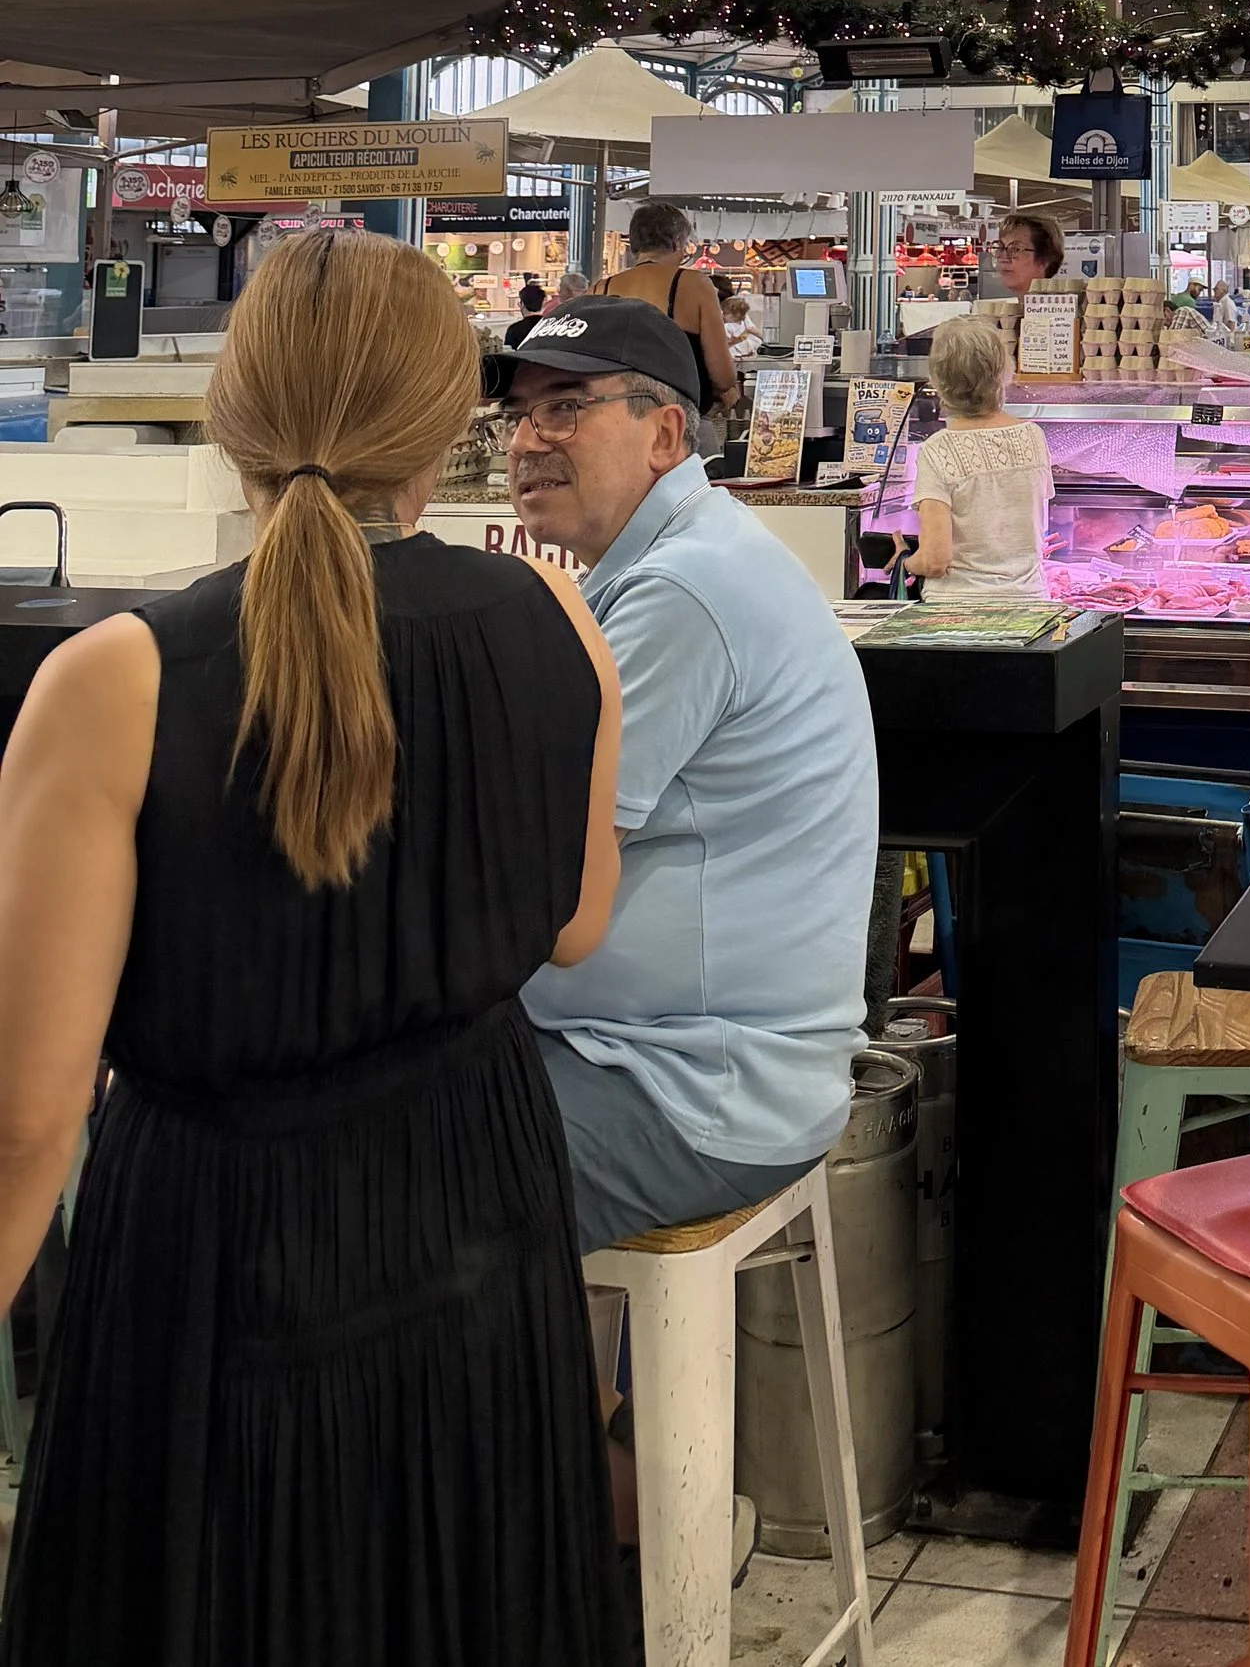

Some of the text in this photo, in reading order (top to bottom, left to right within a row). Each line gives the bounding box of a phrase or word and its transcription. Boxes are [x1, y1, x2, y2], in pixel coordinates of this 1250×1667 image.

[241, 126, 471, 150] LES RUCHERS DU MOULIN
[293, 149, 415, 167] APICULTEUR RÉCOLTANT
[1061, 155, 1129, 167] Halles de Dijon
[250, 174, 270, 184] MIEL
[279, 172, 301, 183] PAIN
[350, 170, 395, 181] PRODUITS
[398, 169, 410, 179] DE
[413, 169, 426, 179] LA
[428, 168, 461, 178] RUCHE
[147, 179, 206, 199] ucherie
[265, 186, 292, 196] FAMILLE
[357, 183, 385, 194] SAVOISY
[391, 183, 401, 192] 06
[402, 182, 411, 192] 71
[424, 182, 433, 191] 17
[434, 182, 443, 191] 57
[881, 192, 956, 203] 21170 FRANXAULT
[854, 381, 866, 390] NE
[858, 389, 886, 400] PAS !
